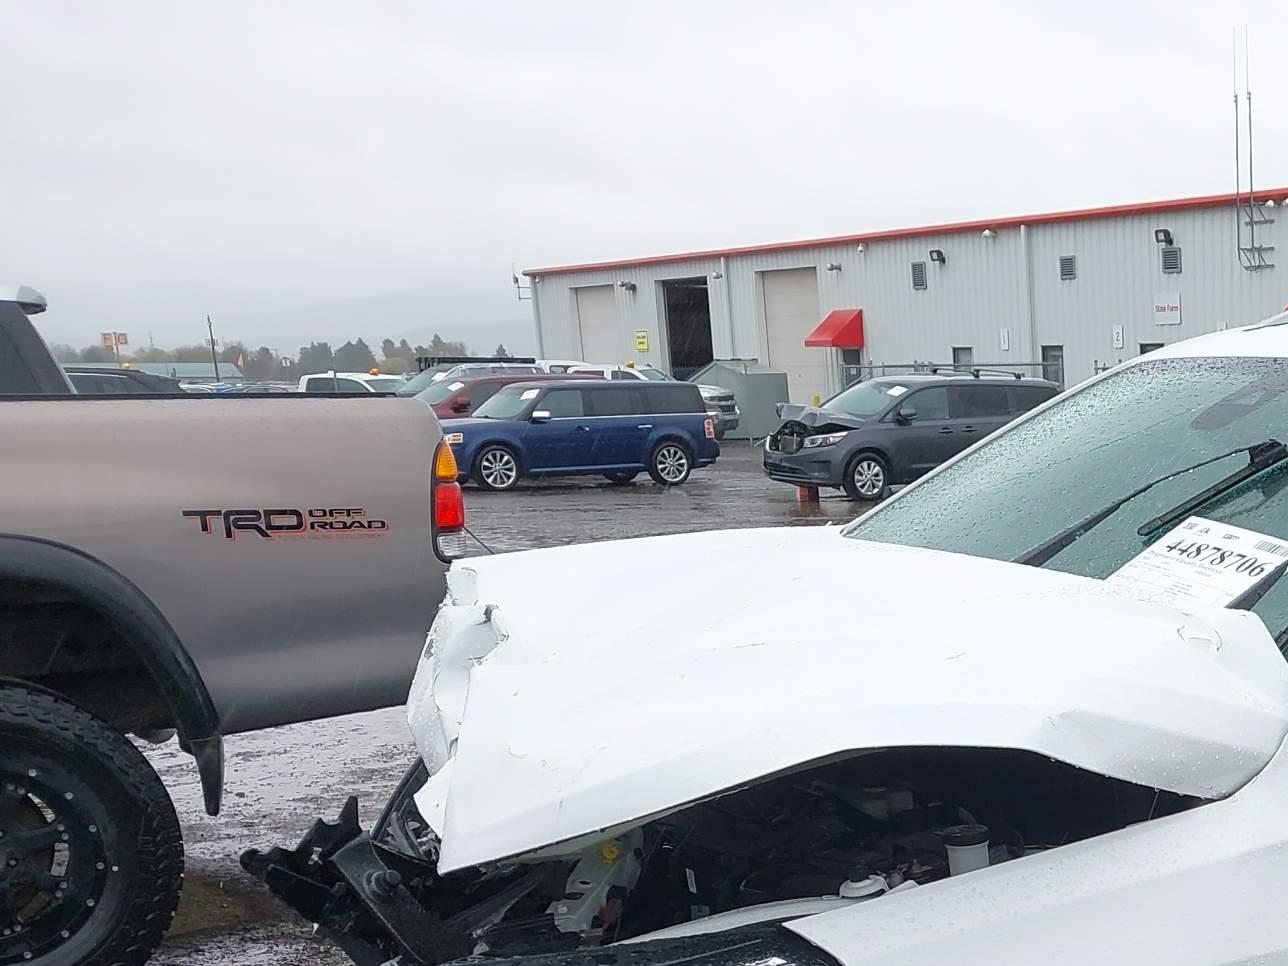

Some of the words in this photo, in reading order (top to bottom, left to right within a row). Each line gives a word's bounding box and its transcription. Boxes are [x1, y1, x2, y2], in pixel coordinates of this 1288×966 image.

[1155, 304, 1166, 313] State
[1167, 304, 1179, 312] Farm
[1115, 331, 1121, 342] 2
[308, 507, 366, 519] OFF
[182, 508, 306, 541] TRD
[310, 520, 390, 532] ROAD
[1166, 538, 1273, 577] 44878706
